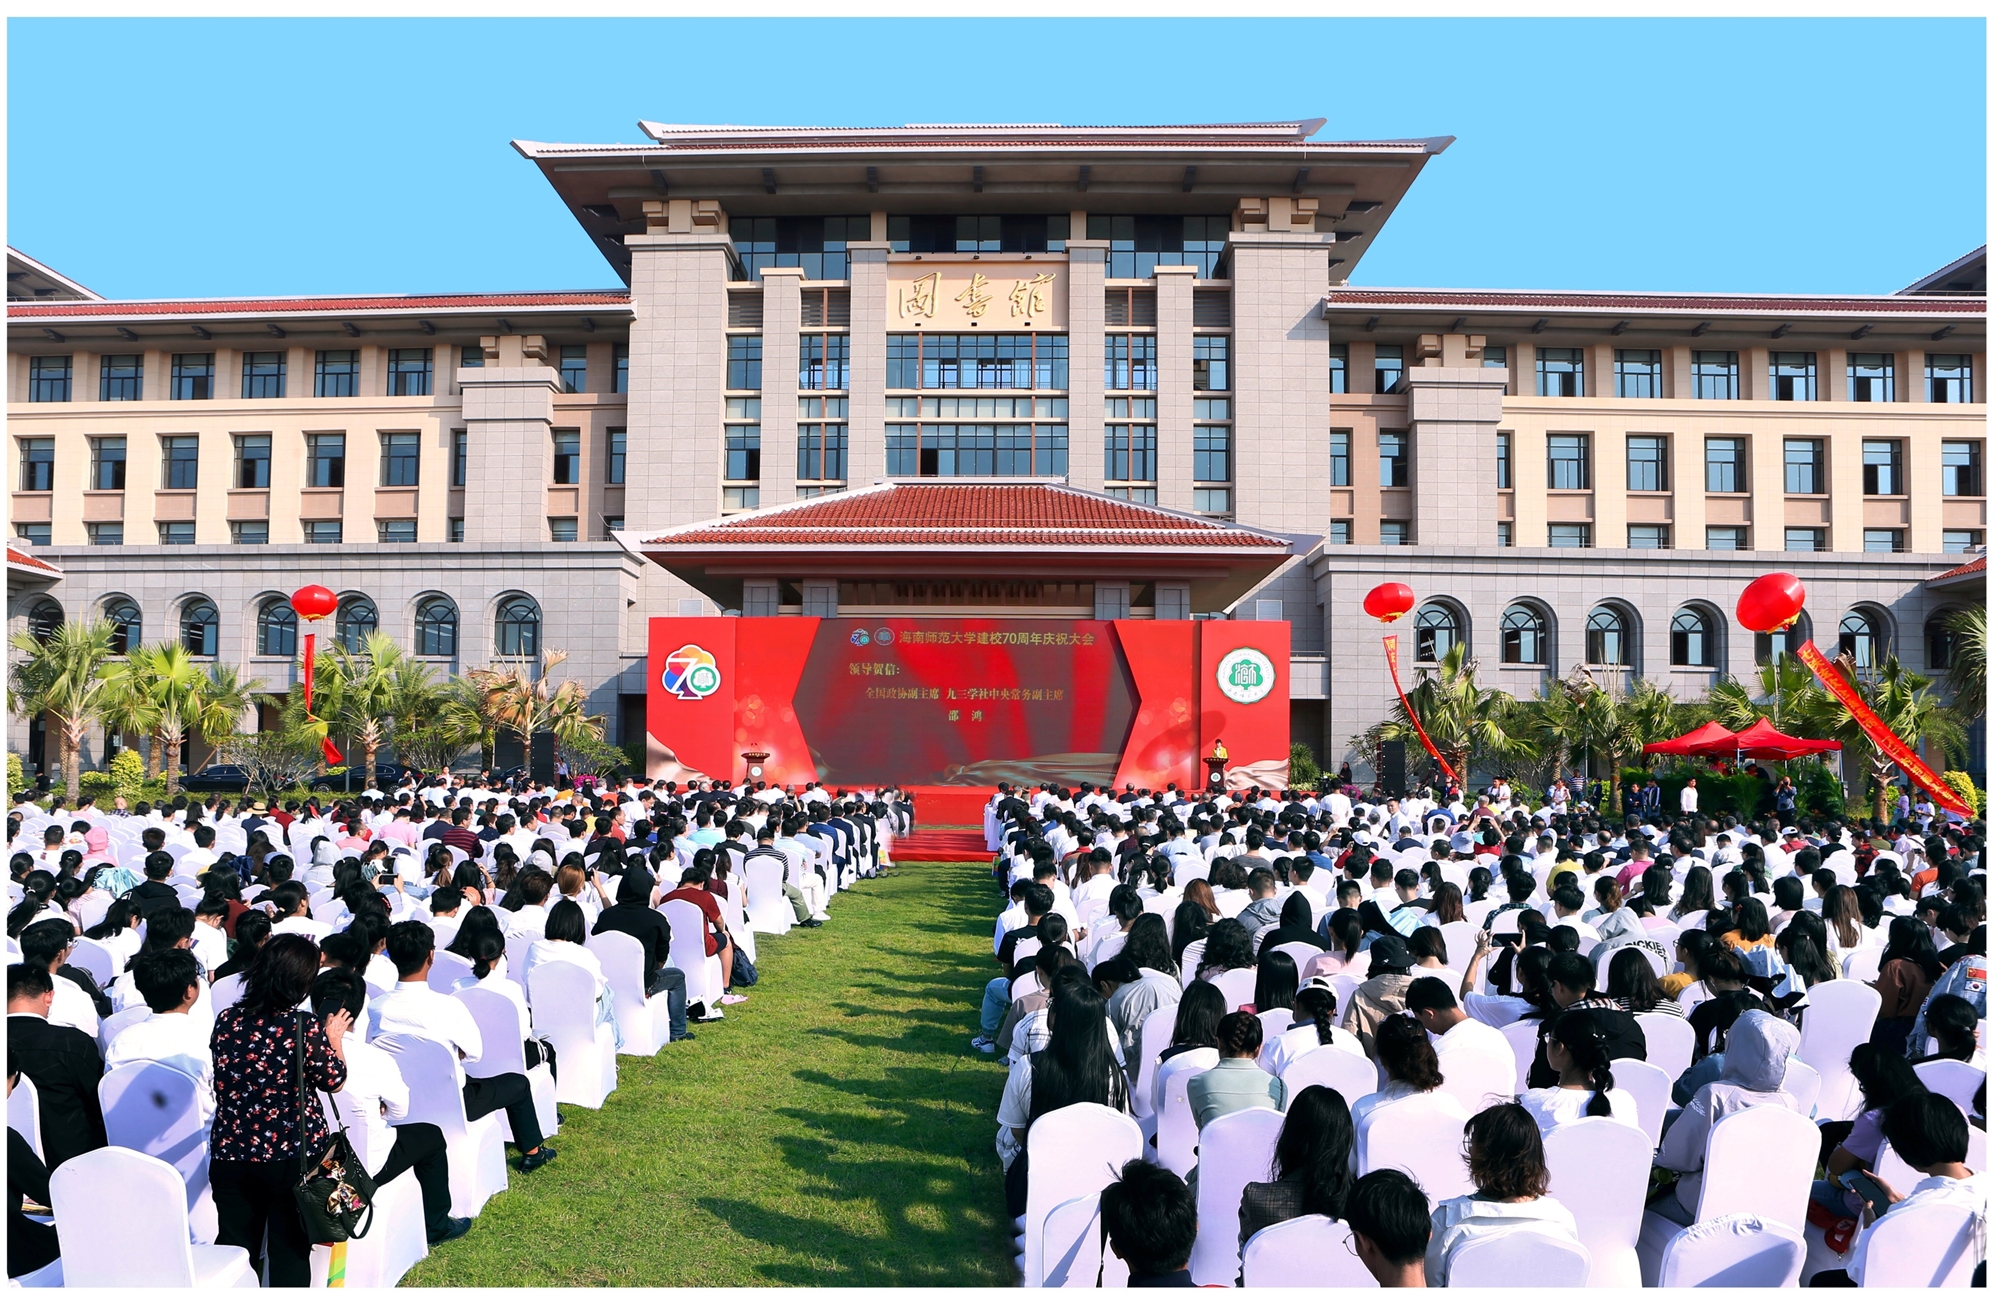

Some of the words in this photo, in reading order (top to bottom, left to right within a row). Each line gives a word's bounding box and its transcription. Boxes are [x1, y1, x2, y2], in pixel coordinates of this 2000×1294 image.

[899, 631, 1095, 646] 海南师范大学建校70周年庆祝大会
[866, 687, 939, 700] 全国政协副主席
[946, 688, 1064, 701] 九三学社中央常务副主席
